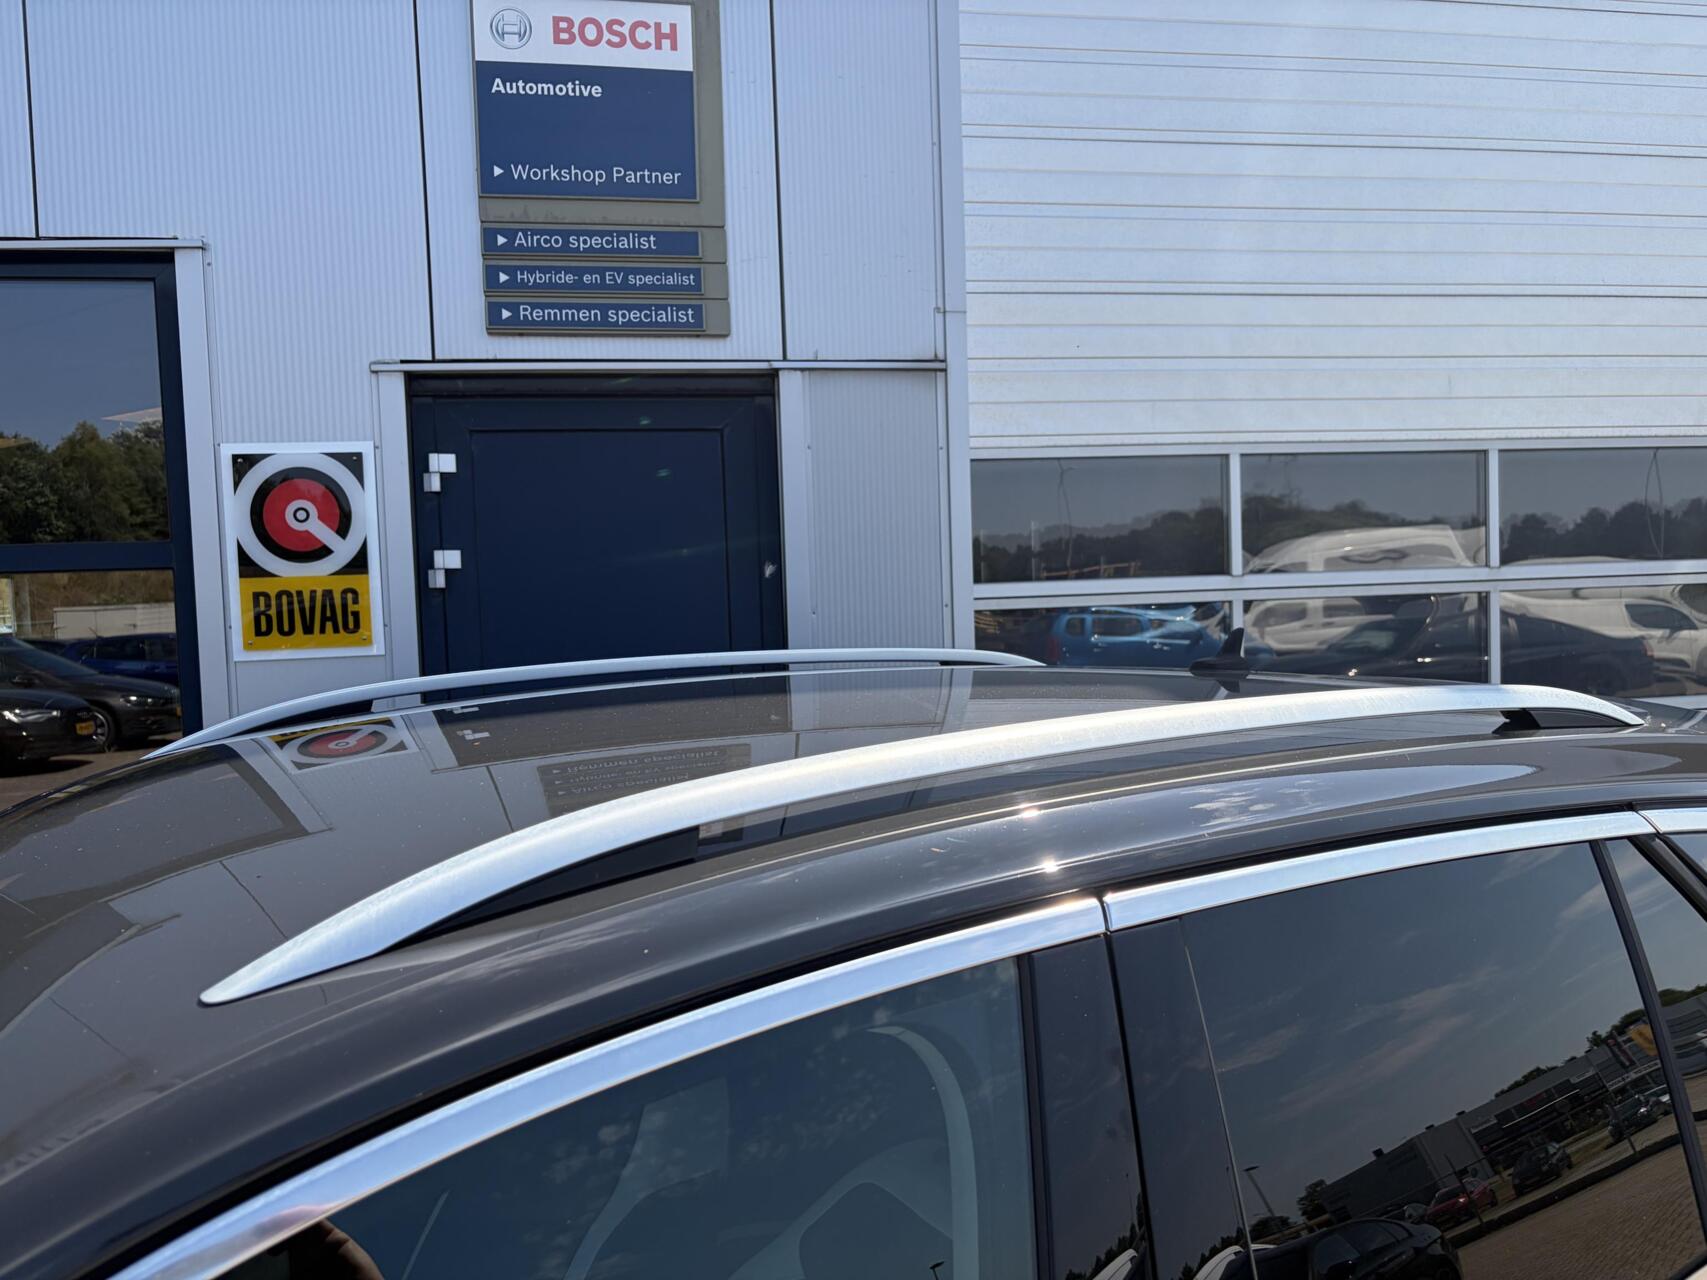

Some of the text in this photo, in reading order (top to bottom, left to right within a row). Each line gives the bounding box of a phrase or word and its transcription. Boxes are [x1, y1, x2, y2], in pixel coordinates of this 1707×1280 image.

[552, 15, 678, 51] BOSCH
[491, 78, 602, 97] Automotive
[511, 164, 681, 185] Workshop Partner
[514, 232, 656, 251] Airco specialist
[517, 271, 695, 289] Hybride- en EV specialist
[519, 306, 694, 325] Remmen specialist
[252, 588, 361, 637] BOVAG
